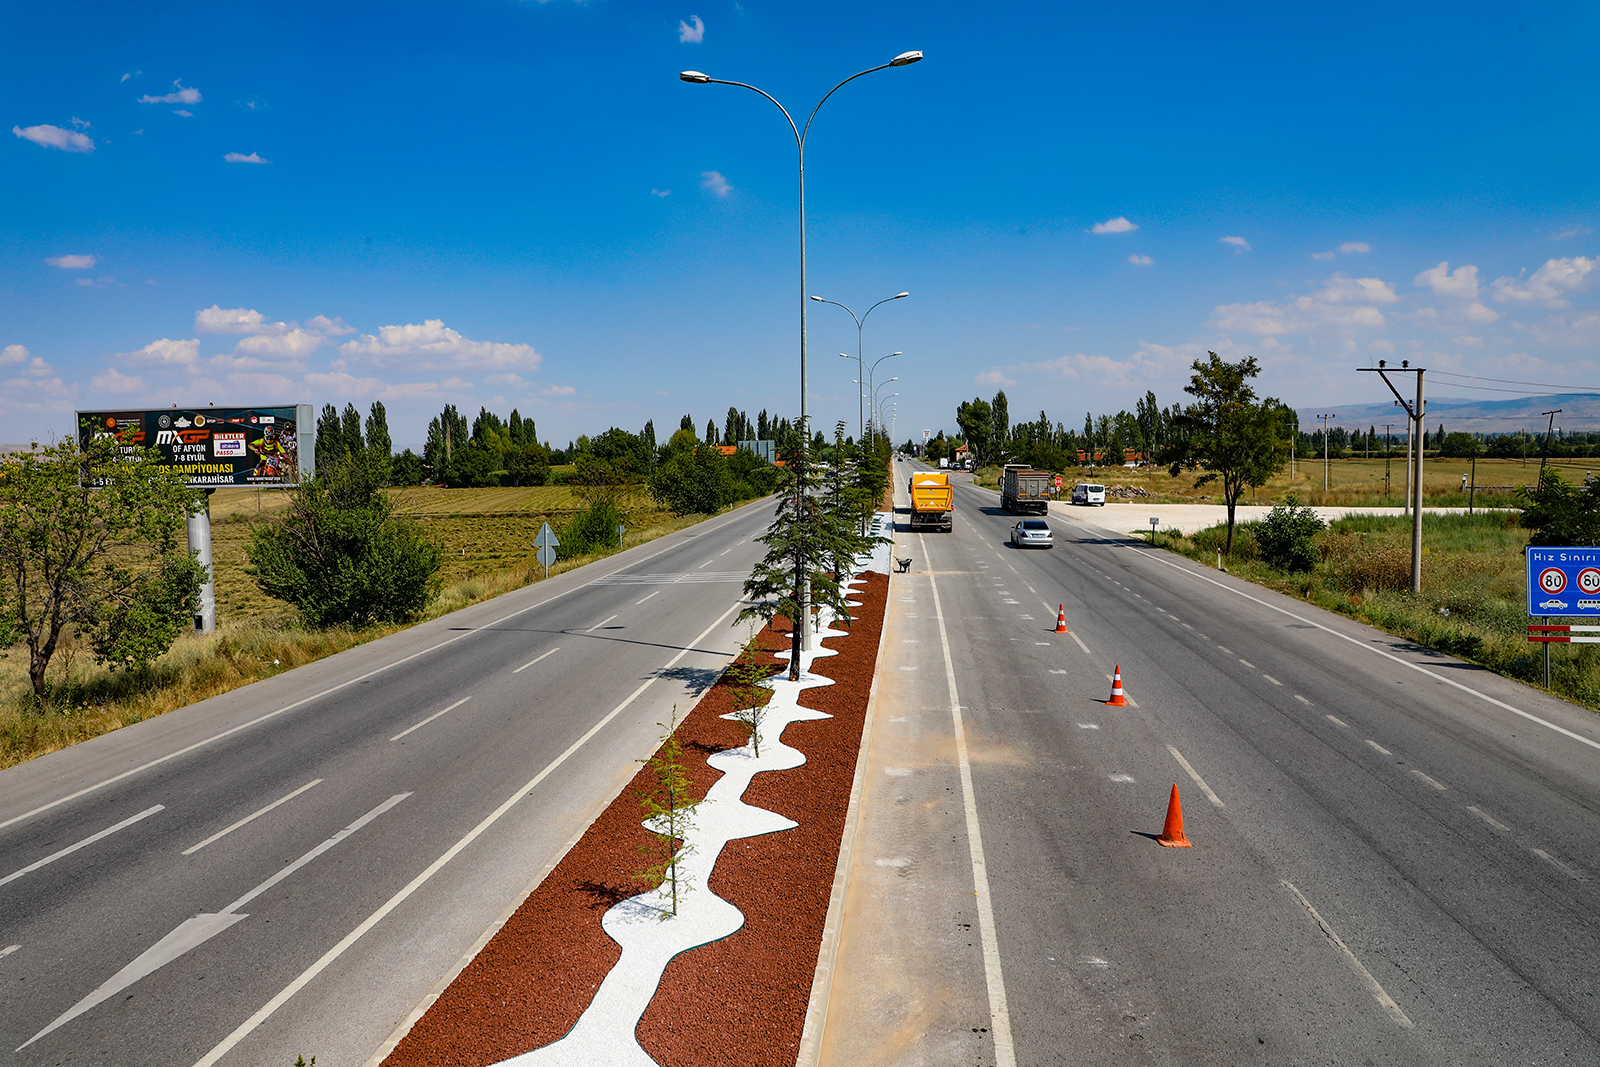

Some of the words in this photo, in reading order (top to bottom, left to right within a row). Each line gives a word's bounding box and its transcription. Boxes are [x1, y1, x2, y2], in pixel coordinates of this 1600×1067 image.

[156, 430, 210, 445] MXGP
[1534, 553, 1554, 561] Hız
[1560, 553, 1596, 561] Sınırı
[1545, 575, 1562, 587] 80
[1584, 575, 1600, 587] 60
